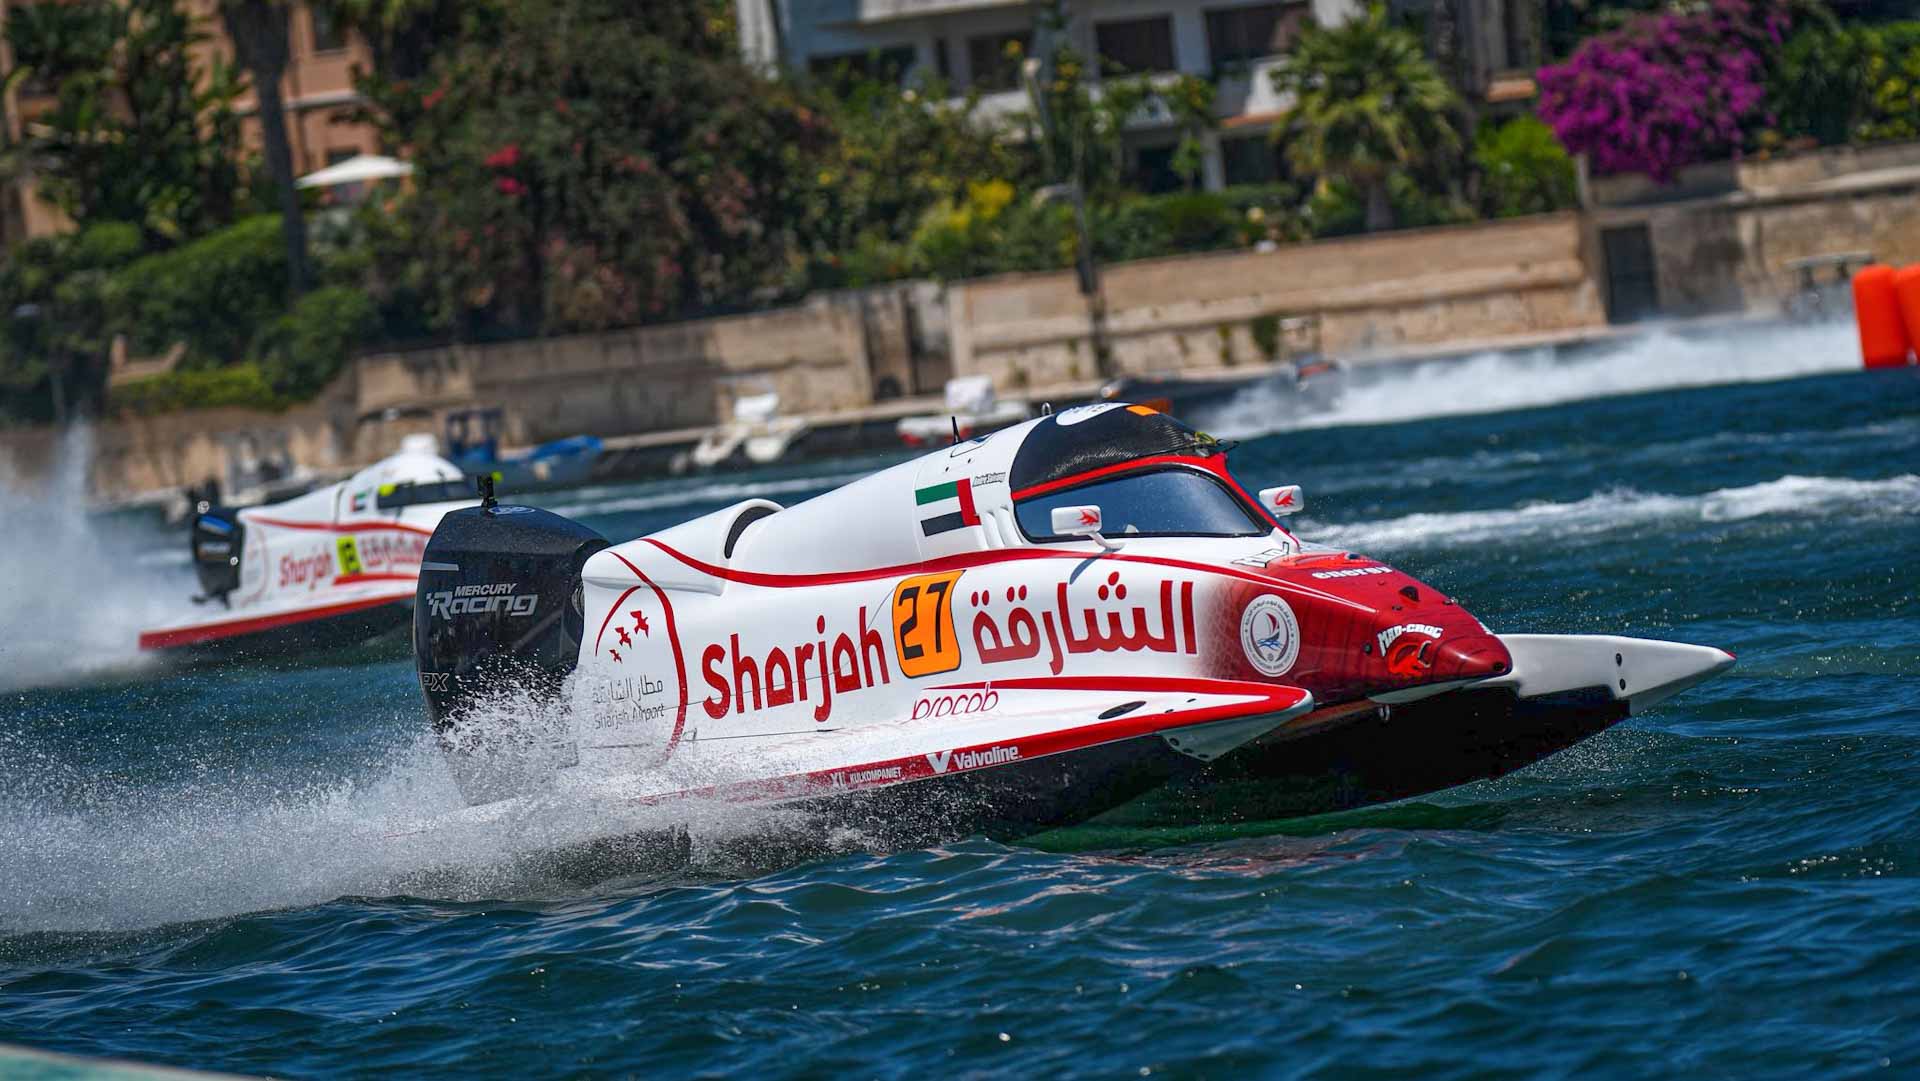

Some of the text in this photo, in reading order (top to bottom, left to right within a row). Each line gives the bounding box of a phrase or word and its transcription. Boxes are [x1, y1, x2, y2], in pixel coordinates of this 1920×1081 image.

[427, 592, 539, 620] Racing
[455, 583, 518, 596] MERCURY
[897, 580, 951, 660] 27
[971, 571, 1197, 676] الشارقة
[637, 674, 664, 701] مطار
[702, 606, 890, 722] Sharjah
